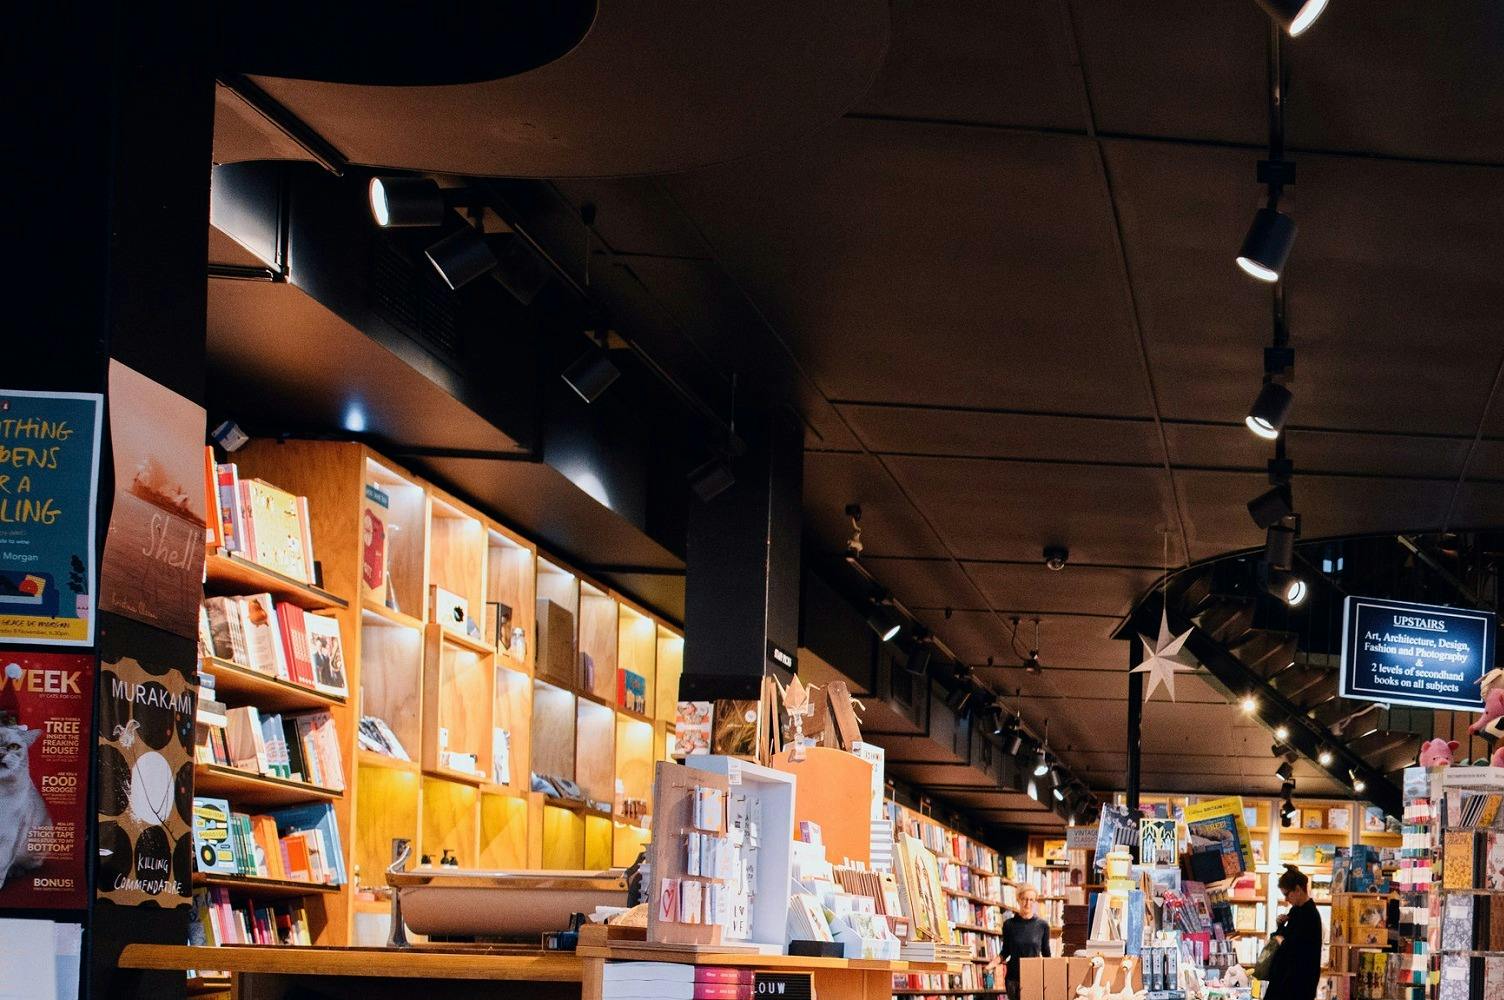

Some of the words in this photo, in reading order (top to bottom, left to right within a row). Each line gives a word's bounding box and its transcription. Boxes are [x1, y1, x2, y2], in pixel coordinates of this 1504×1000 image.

[0, 418, 74, 441] THING
[0, 499, 62, 525] LING
[142, 512, 198, 571] Shell
[3, 552, 38, 562] Morgan
[1393, 615, 1445, 630] UPSTAIRS
[1365, 631, 1381, 641] Art,
[1383, 632, 1437, 648] Architecture,
[1438, 639, 1470, 652] Design,
[1364, 642, 1397, 654] Fashion
[1399, 646, 1413, 656] and
[1415, 648, 1468, 663] Photography
[1415, 658, 1424, 667] &
[1371, 663, 1377, 672] 2
[1379, 663, 1403, 675] levels
[1404, 666, 1415, 676] of
[1415, 668, 1464, 681] secondhand
[1374, 675, 1399, 687] books
[1401, 679, 1411, 688] on
[1413, 678, 1424, 689] all
[1426, 681, 1459, 693] subjects
[111, 678, 192, 715] MURAKAMI
[44, 720, 80, 734] TREE
[42, 746, 79, 755] HOUSE?
[42, 776, 77, 787] FOOD
[28, 830, 55, 839] STICKY
[137, 852, 169, 874] KILLING
[33, 878, 74, 888] BONUS!
